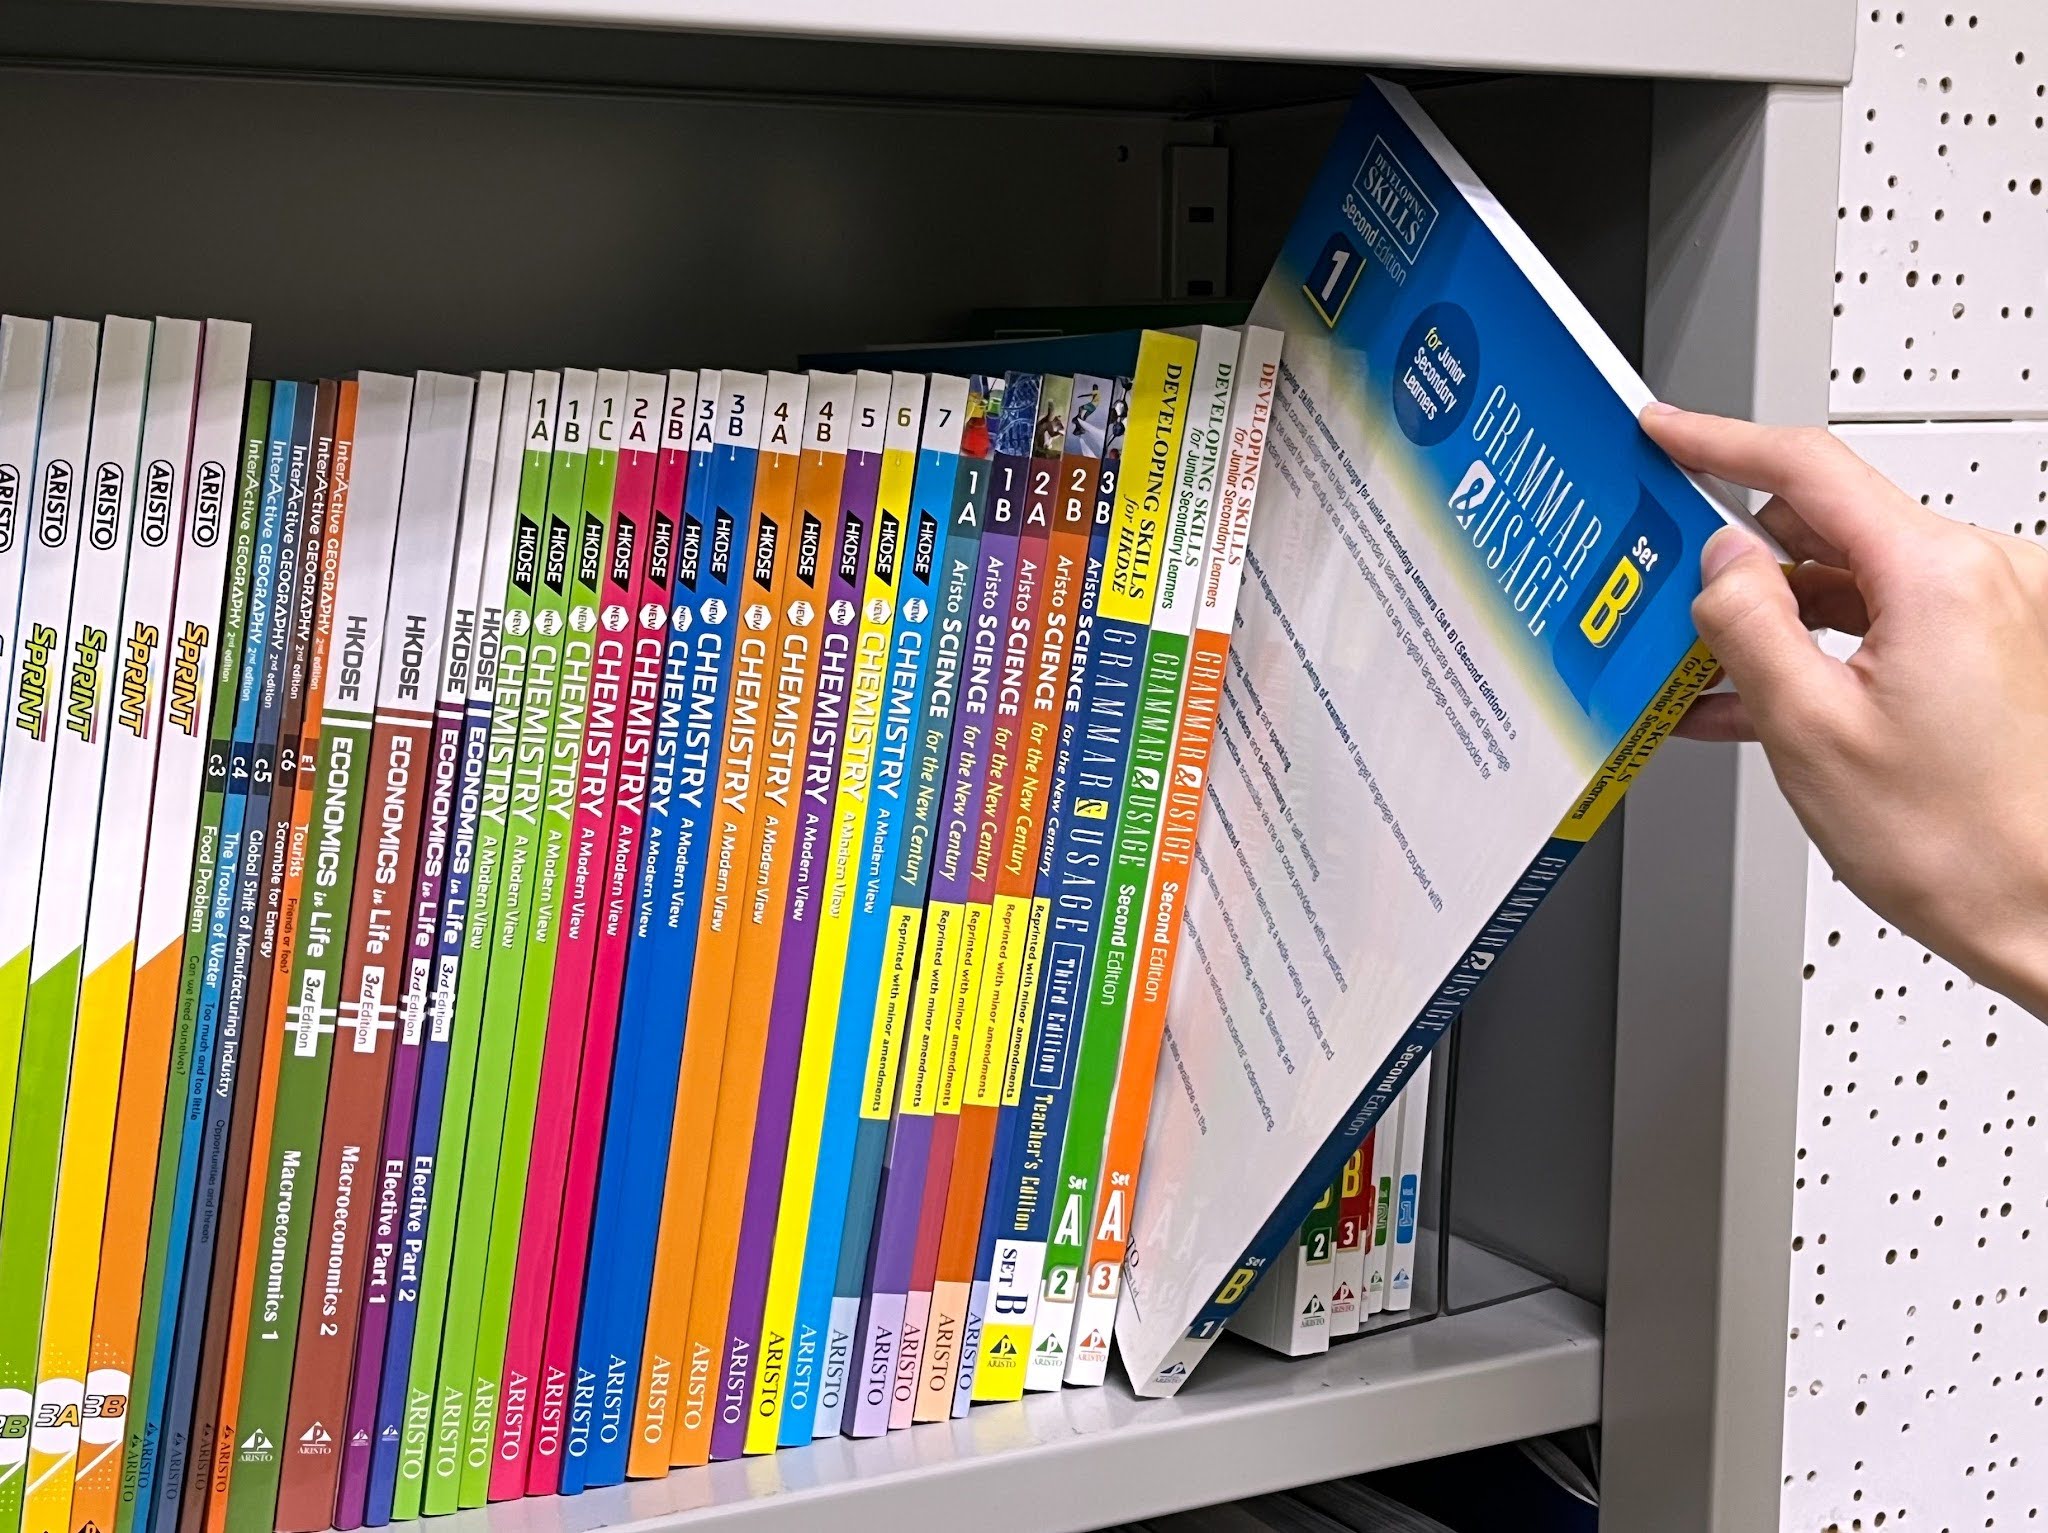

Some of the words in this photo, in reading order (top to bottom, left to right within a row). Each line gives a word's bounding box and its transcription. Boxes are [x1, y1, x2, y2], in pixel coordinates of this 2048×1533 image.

[1364, 166, 1420, 245] SKILLS
[1375, 153, 1426, 222] DEVELOPING
[1342, 194, 1379, 247] Second
[1373, 236, 1406, 287] Edition
[1321, 250, 1350, 301] 1
[1414, 347, 1458, 413] Secondary
[1425, 326, 1443, 351] for
[1437, 347, 1467, 386] Junior
[860, 409, 876, 428] 5
[896, 407, 912, 427] 6
[938, 409, 952, 427] 7
[1403, 369, 1437, 420] Learners
[1143, 362, 1183, 513] DEVELOPING
[1189, 427, 1205, 447] for
[1198, 362, 1232, 493] DEVELOPING
[236, 439, 262, 530] InterActive
[259, 441, 287, 539] InterActive
[281, 445, 307, 547] InterActive
[308, 436, 333, 535] InterActive
[1182, 451, 1200, 493] Junior
[1472, 384, 1602, 580] GRAMMAR
[42, 465, 68, 543] ARISTO
[93, 467, 119, 545] ARISTO
[144, 464, 171, 542] ARISTO
[195, 465, 222, 542] ARISTO
[1123, 494, 1140, 524] for
[1173, 490, 1193, 557] Secondary
[1185, 497, 1209, 568] SKILLS
[515, 526, 536, 583] HKDSE
[711, 518, 732, 573] HKDSE
[915, 520, 936, 574] HKDSE
[1111, 526, 1134, 594] HKDSE
[1129, 519, 1155, 600] SKILLS
[1472, 489, 1569, 637] USAGE
[1632, 536, 1658, 572] Set
[227, 534, 250, 629] GEOGRAPHY
[250, 541, 273, 645] GEOGRAPHY
[270, 550, 295, 650] GEOGRAPHY
[297, 538, 320, 639] GEOGRAPHY
[947, 559, 969, 613] Aristo
[982, 556, 1004, 610] Aristo
[1053, 555, 1073, 604] Aristo
[1083, 558, 1103, 610] Aristo
[1162, 558, 1180, 609] Learners
[1579, 555, 1643, 649] B
[118, 620, 158, 737] SPRINT
[169, 620, 209, 736] SPRINT
[338, 615, 368, 702] HKDSE
[397, 614, 427, 702] HKDSE
[447, 608, 474, 694] HKDSE
[474, 607, 502, 692] HKDSE
[929, 619, 962, 718] SCIENCE
[967, 614, 999, 715] SCIENCE
[1033, 613, 1066, 712] SCIENCE
[1064, 613, 1094, 712] SCIENCE
[16, 623, 57, 739] SPRINT
[66, 624, 107, 741] SPRINT
[1079, 628, 1137, 789] GRAMMAR
[1136, 652, 1180, 762] GRAMMAR
[1455, 641, 1483, 684] (Second
[1479, 681, 1507, 721] Edition)
[511, 645, 557, 825] CHEMISTRY
[579, 639, 623, 819] CHEMISTRY
[617, 638, 663, 816] CHEMISTRY
[678, 633, 722, 809] CHEMISTRY
[804, 633, 849, 805] CHEMISTRY
[877, 632, 922, 800] CHEMISTRY
[1032, 721, 1048, 749] for
[1025, 750, 1043, 779] the
[316, 736, 354, 887] ECONOMICS
[375, 735, 413, 884] ECONOMICS
[424, 729, 459, 877] ECONOMICS
[453, 727, 487, 874] ECONOMICS
[1021, 782, 1039, 820] New
[199, 825, 218, 864] Food
[223, 833, 240, 858] The
[245, 830, 264, 876] Global
[271, 821, 290, 884] Scramble
[289, 824, 309, 877] Tourists
[582, 827, 595, 839] A
[1005, 821, 1032, 877] Century
[1119, 795, 1156, 867] USAGE
[215, 863, 235, 918] Trouble
[241, 880, 257, 911] Shift
[268, 888, 281, 906] for
[314, 892, 327, 907] in
[373, 888, 386, 904] in
[575, 842, 593, 898] Modern
[1055, 826, 1105, 933] USAGE
[190, 868, 212, 933] Problem
[239, 916, 252, 931] of
[284, 898, 297, 934] Friends
[415, 902, 436, 947] Life
[444, 899, 465, 944] Life
[568, 901, 585, 941] View
[1109, 885, 1135, 946] Second
[1477, 856, 1567, 953] GRAMMAR
[213, 923, 227, 939] of
[260, 911, 278, 958] Energy
[307, 911, 332, 957] Life
[366, 909, 392, 954] Life
[929, 909, 950, 967] Reprinted
[206, 943, 226, 988] Water
[224, 933, 250, 1037] Manufacturing
[304, 977, 321, 1002] 3rd
[927, 969, 941, 998] with
[1052, 958, 1076, 1010] Third
[1102, 943, 1125, 1005] Edition
[298, 1005, 314, 1048] Edition
[921, 1001, 938, 1039] minor
[1416, 970, 1480, 1032] USAGE
[216, 1041, 238, 1097] Industry
[1039, 1014, 1067, 1074] Edition
[1378, 1043, 1423, 1092] Second
[912, 1042, 932, 1109] amendments
[1024, 1094, 1055, 1171] Teacher's
[1344, 1094, 1386, 1137] Edition
[377, 1160, 403, 1236] Elective
[406, 1155, 432, 1232] Elective
[1014, 1174, 1041, 1231] Edition
[1068, 1174, 1088, 1191] Set
[264, 1149, 301, 1322] Macroeconomics
[322, 1145, 360, 1316] Macroeconomics
[1054, 1193, 1085, 1246] A
[1314, 1234, 1326, 1258] 2
[1344, 1222, 1354, 1245] 3
[371, 1243, 392, 1286] Part
[400, 1239, 422, 1282] Part
[997, 1247, 1018, 1288] SET
[1053, 1270, 1068, 1294] 2
[1215, 1269, 1258, 1305] B
[369, 1294, 386, 1304] 1
[398, 1288, 416, 1302] 2
[994, 1292, 1029, 1316] B
[261, 1331, 279, 1340] 1
[320, 1323, 338, 1336] 2
[1199, 1320, 1214, 1337] 1
[600, 1354, 627, 1444] ARISTO
[683, 1342, 711, 1431] ARISTO
[759, 1332, 785, 1418] ARISTO
[35, 1404, 79, 1427] 3A
[83, 1395, 127, 1417] 3B
[402, 1387, 430, 1480] ARISTO
[538, 1366, 566, 1456] ARISTO
